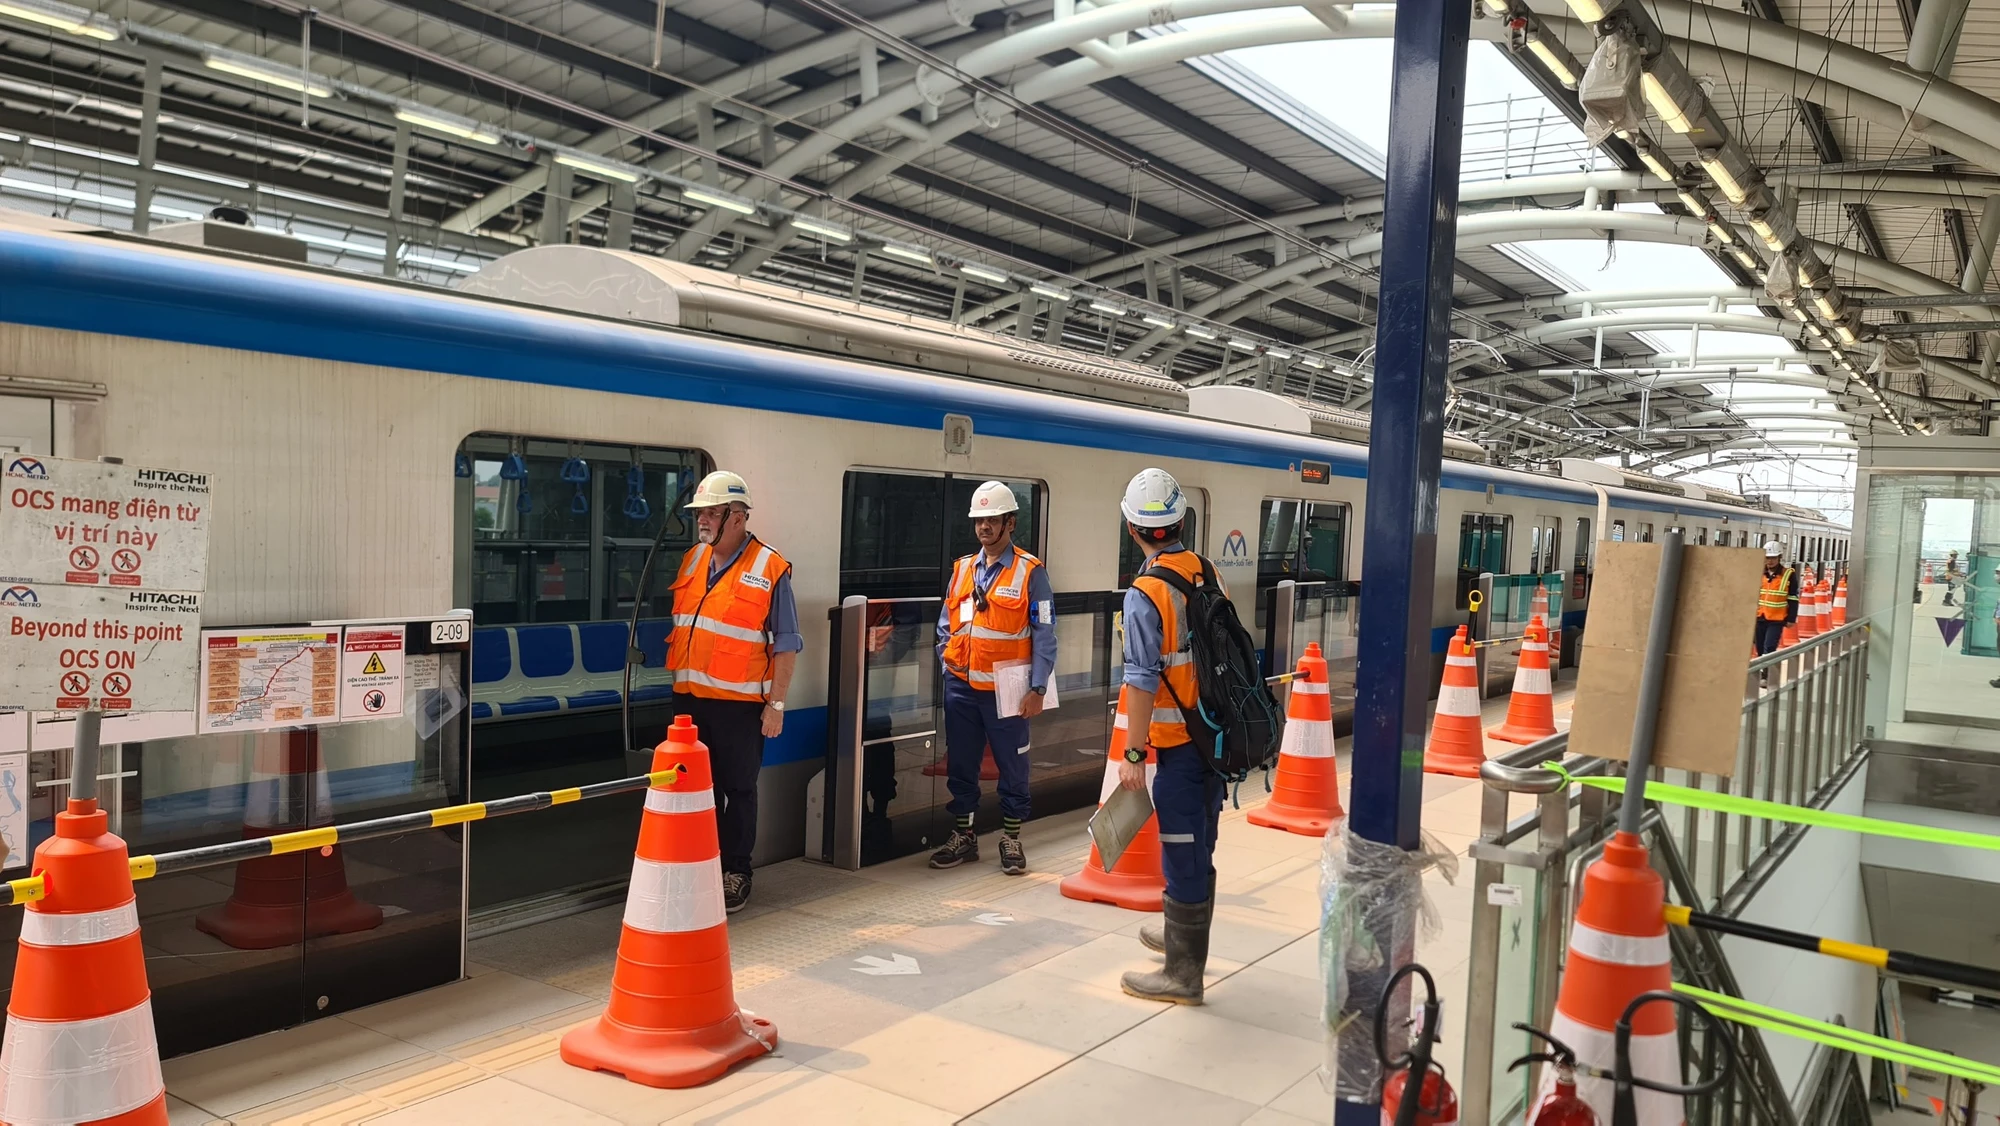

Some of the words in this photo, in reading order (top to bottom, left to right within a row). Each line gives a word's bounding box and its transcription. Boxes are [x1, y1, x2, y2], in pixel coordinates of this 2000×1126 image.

[138, 469, 206, 485] HITACHI
[134, 480, 167, 490] Inspire
[170, 483, 185, 491] the
[188, 485, 209, 494] Next
[12, 488, 55, 510] OCS
[62, 496, 120, 520] mang
[126, 498, 170, 522] điện
[177, 502, 200, 522] từ
[54, 521, 74, 545] vị
[82, 523, 110, 543] trí
[116, 525, 158, 550] này
[744, 574, 770, 586] HITACHI
[130, 592, 196, 605] HITACHI
[125, 603, 158, 612] Inspire
[11, 616, 87, 641] Beyond
[93, 618, 128, 639] this
[134, 622, 183, 644] point
[436, 624, 463, 640] 2-09
[60, 649, 99, 668] OCS
[106, 650, 135, 669] ON
